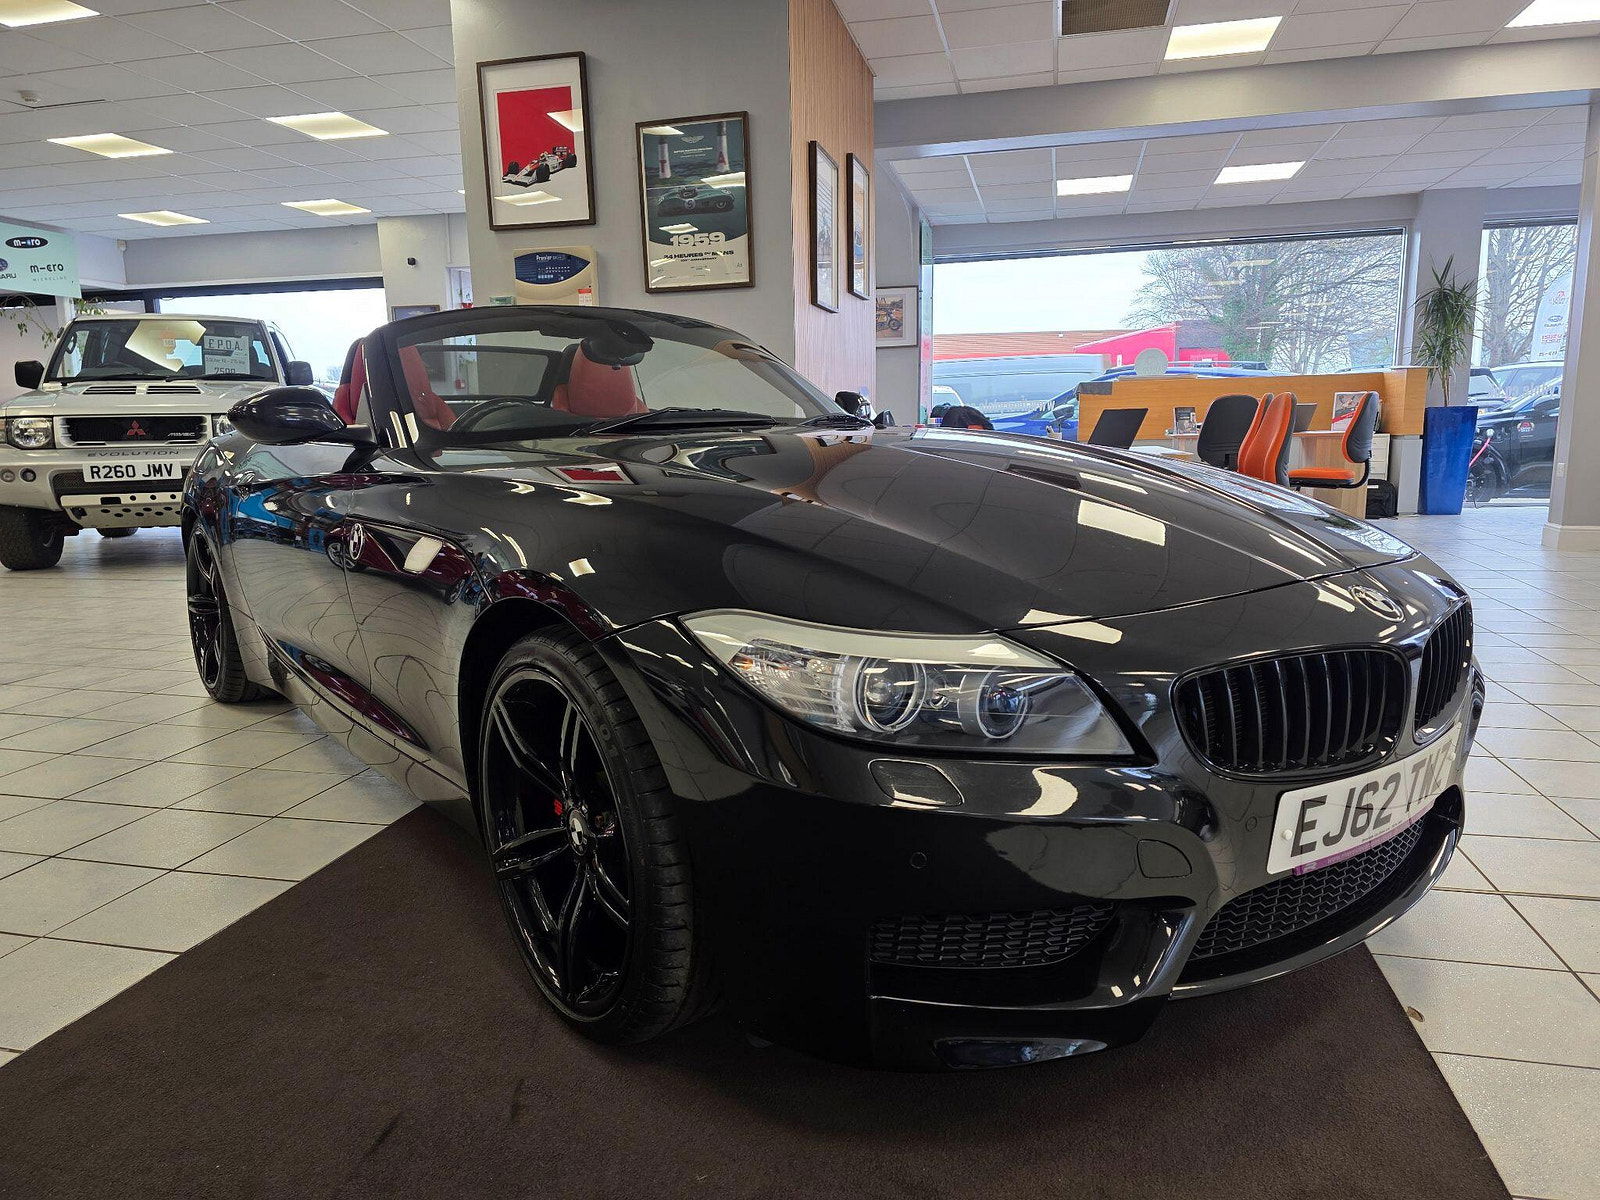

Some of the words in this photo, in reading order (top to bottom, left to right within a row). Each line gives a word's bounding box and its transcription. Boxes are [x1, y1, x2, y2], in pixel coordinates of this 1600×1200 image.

[669, 231, 726, 246] 1959
[88, 450, 179, 458] EVOLUTION
[90, 465, 136, 479] R260
[142, 463, 173, 478] JMV
[1291, 772, 1401, 858] EJ62
